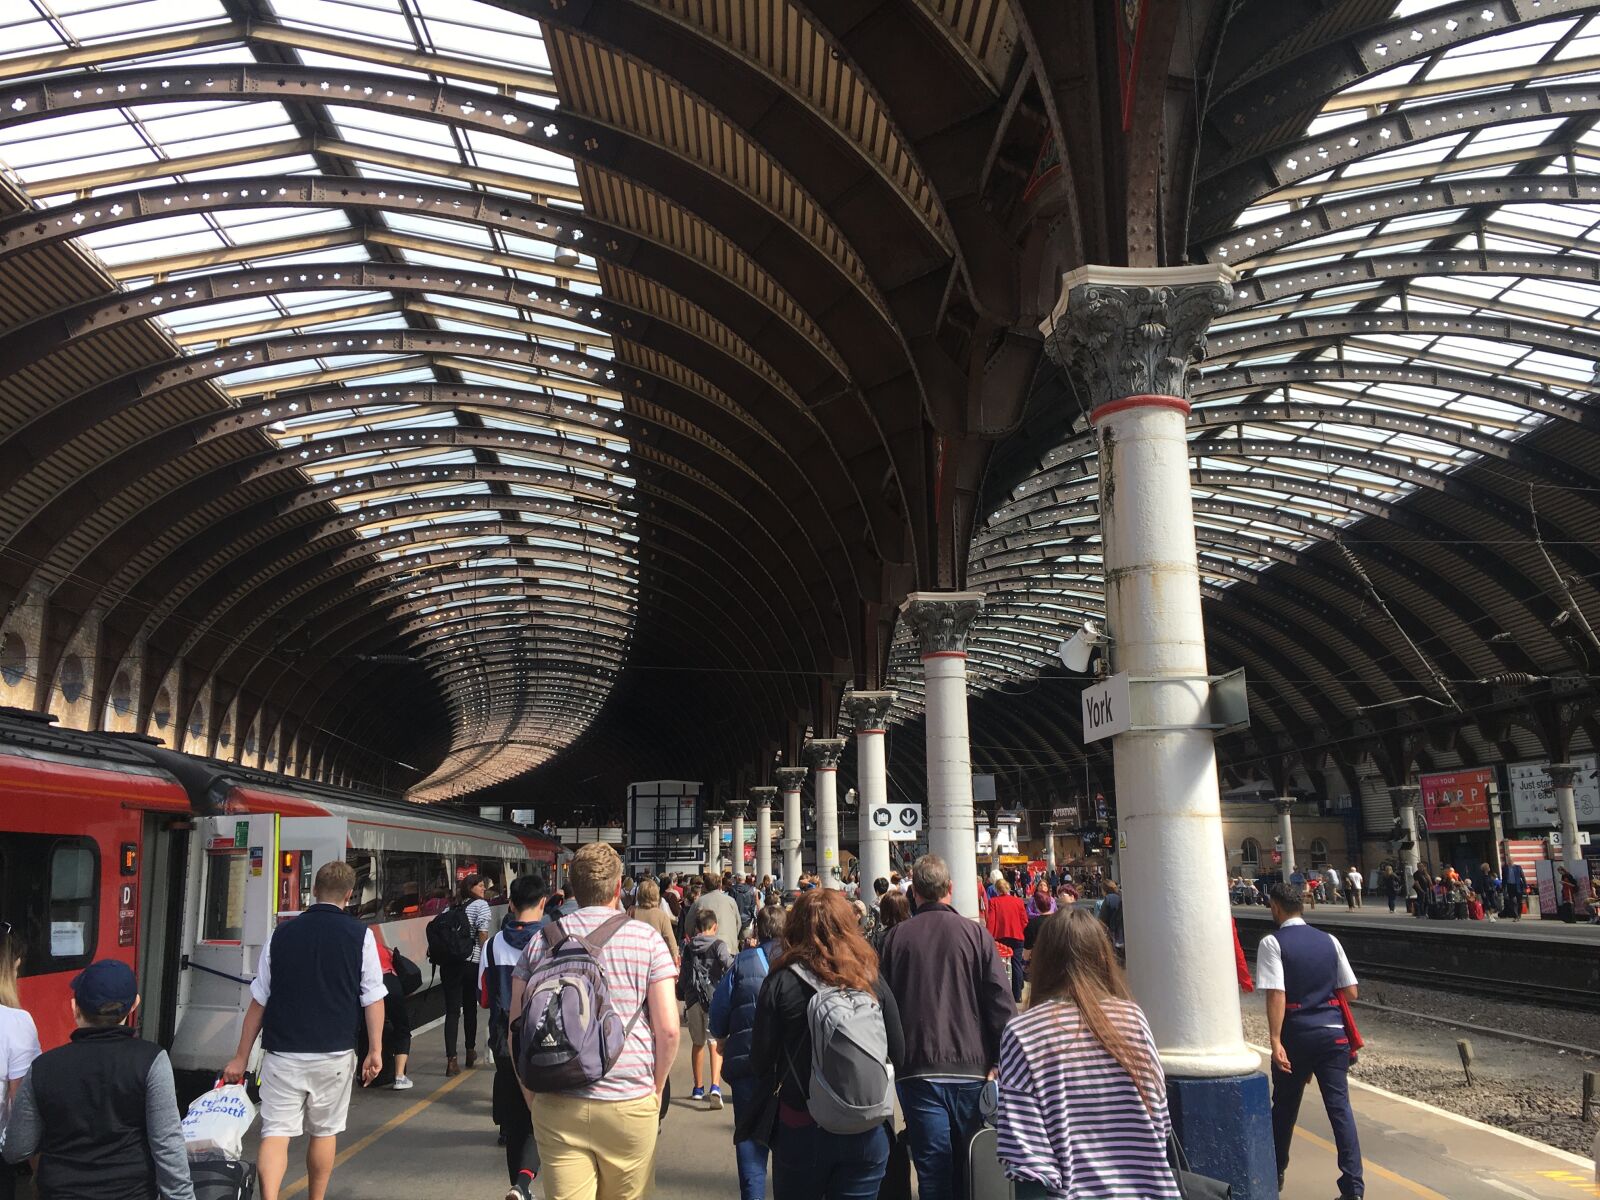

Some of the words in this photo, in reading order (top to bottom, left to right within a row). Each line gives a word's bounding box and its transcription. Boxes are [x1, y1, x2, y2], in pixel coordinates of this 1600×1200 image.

[1086, 690, 1113, 729] York
[1520, 780, 1536, 790] Just
[1552, 833, 1560, 843] 3
[1581, 833, 1587, 843] 1
[123, 886, 131, 904] D
